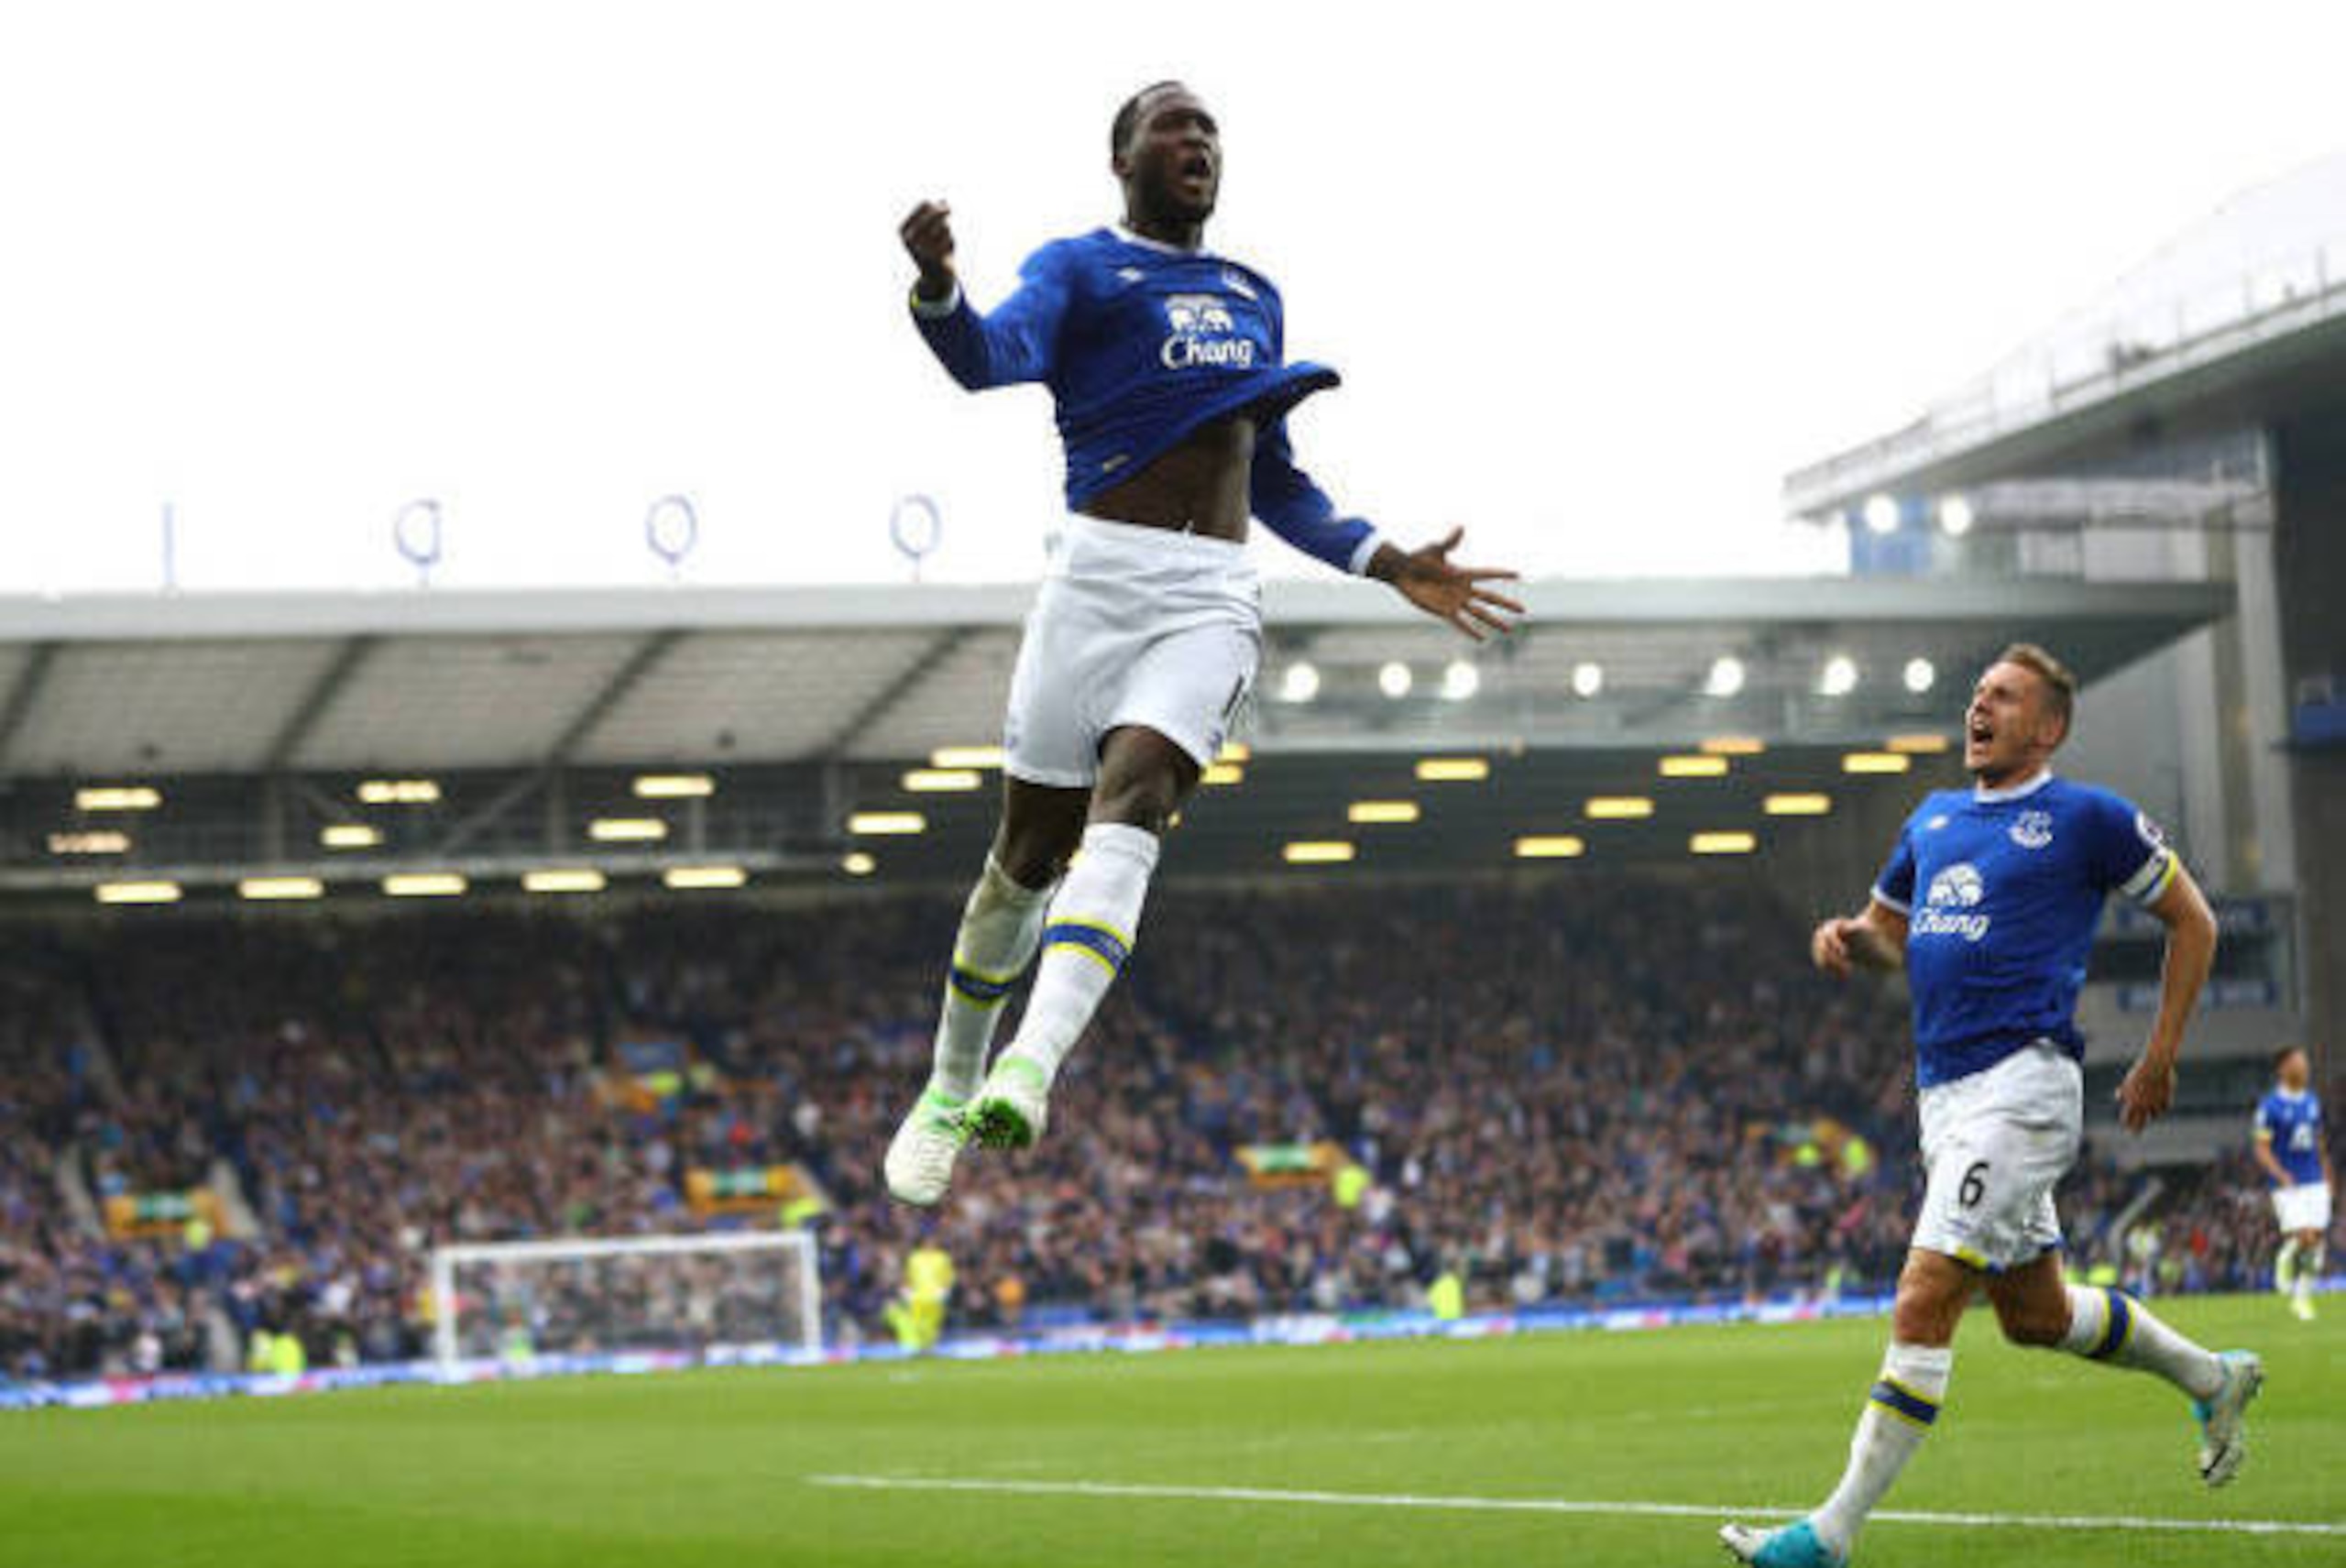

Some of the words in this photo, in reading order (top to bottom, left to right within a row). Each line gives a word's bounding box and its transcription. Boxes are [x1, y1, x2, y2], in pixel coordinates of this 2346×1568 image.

[1161, 334, 1252, 368] Chang
[1912, 906, 1990, 940] Chang
[1959, 1161, 1989, 1208] 6
